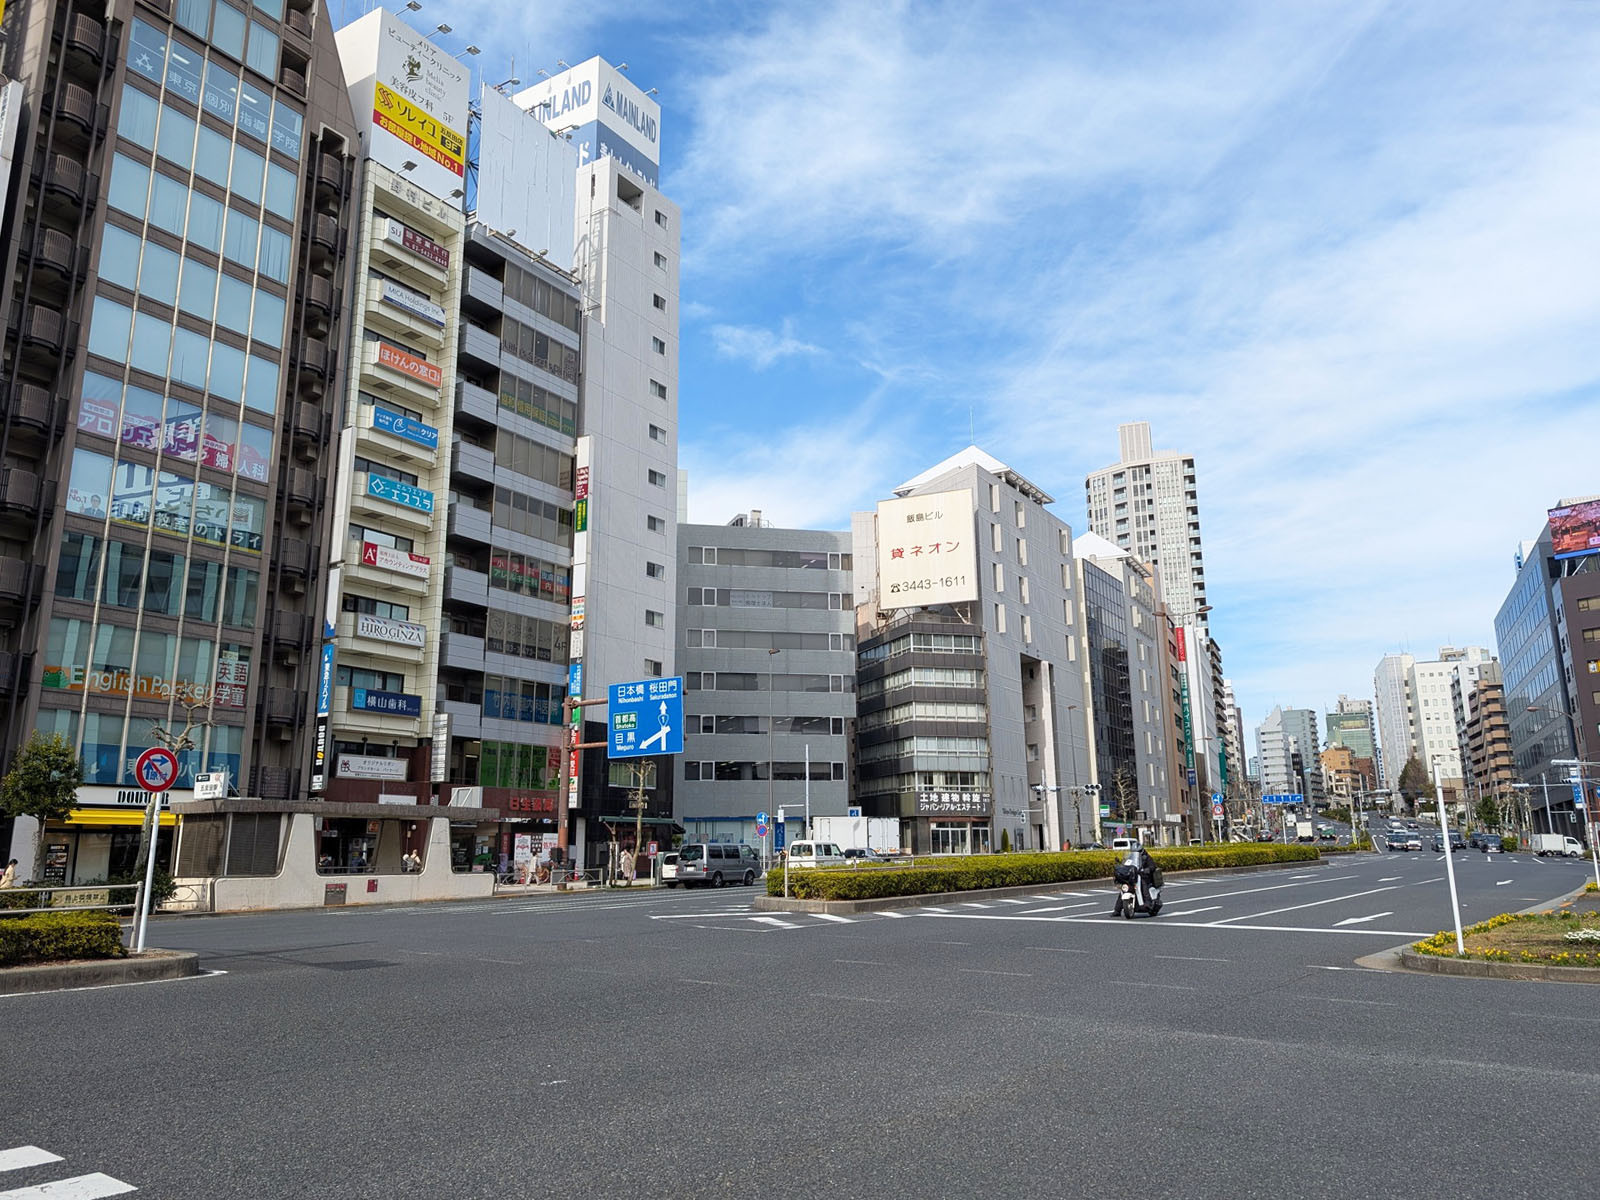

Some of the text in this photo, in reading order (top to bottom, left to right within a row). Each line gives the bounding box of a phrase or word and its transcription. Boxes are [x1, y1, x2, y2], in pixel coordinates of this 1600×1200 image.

[397, 101, 437, 139] ソレイユ
[616, 91, 657, 144] MAINLAND
[444, 139, 459, 155] 9F
[405, 295, 431, 313] Holdings
[421, 428, 438, 439] クリア
[215, 452, 265, 479] 婦人科
[392, 489, 431, 509] エスプラ
[906, 511, 943, 523] 飯島ビル
[891, 542, 960, 560] 貸ネオン
[902, 576, 966, 592] 3443-1611
[70, 664, 147, 693] English
[219, 661, 249, 683] 英語
[216, 684, 246, 707] 学童
[618, 680, 678, 698] 日本橋 桜田門
[367, 695, 407, 711] 横山歯科
[615, 714, 636, 723] 首都高
[615, 732, 635, 744] 目黒
[616, 744, 635, 752] Meguro
[126, 758, 234, 779] 東リバブル
[117, 790, 170, 804] DOUTR
[920, 793, 938, 802] 土地
[941, 793, 960, 802] 建物
